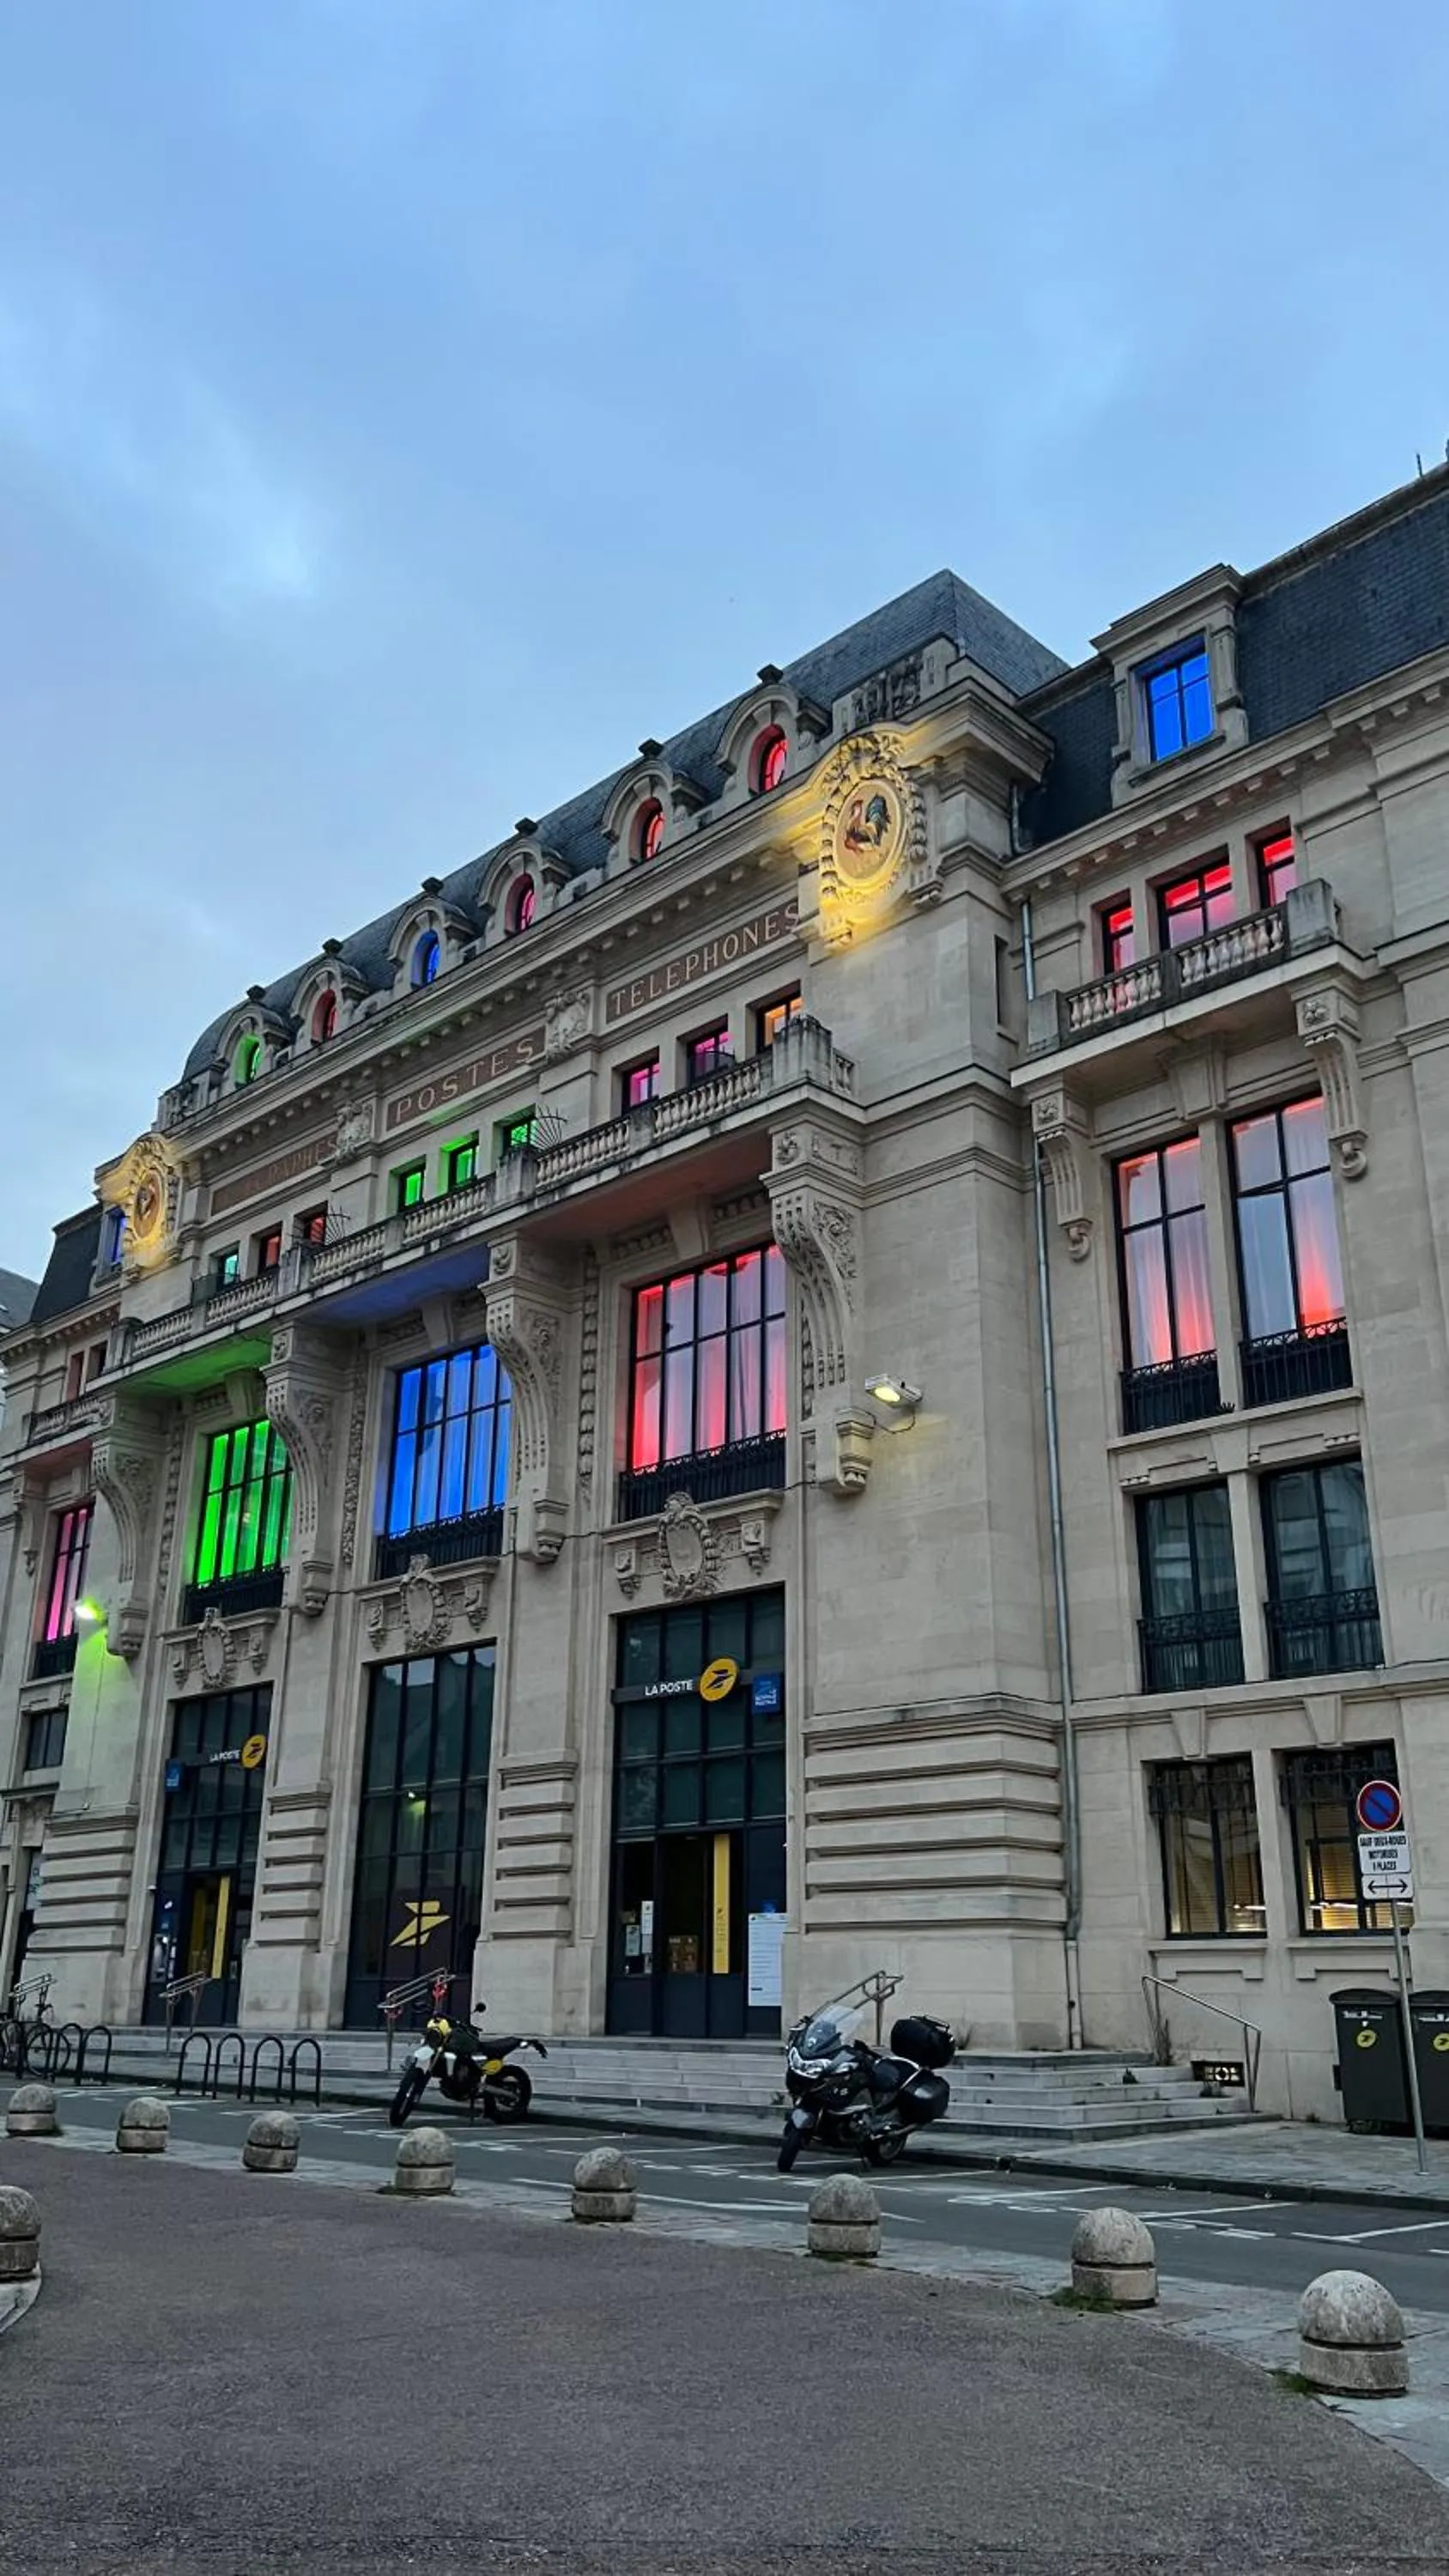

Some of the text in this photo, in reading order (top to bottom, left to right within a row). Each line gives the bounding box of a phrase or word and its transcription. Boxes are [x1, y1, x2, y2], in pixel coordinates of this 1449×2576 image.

[612, 903, 800, 1015] TELEPHONES
[396, 1038, 534, 1122] POSTES
[646, 1680, 694, 1696] LA POSTE
